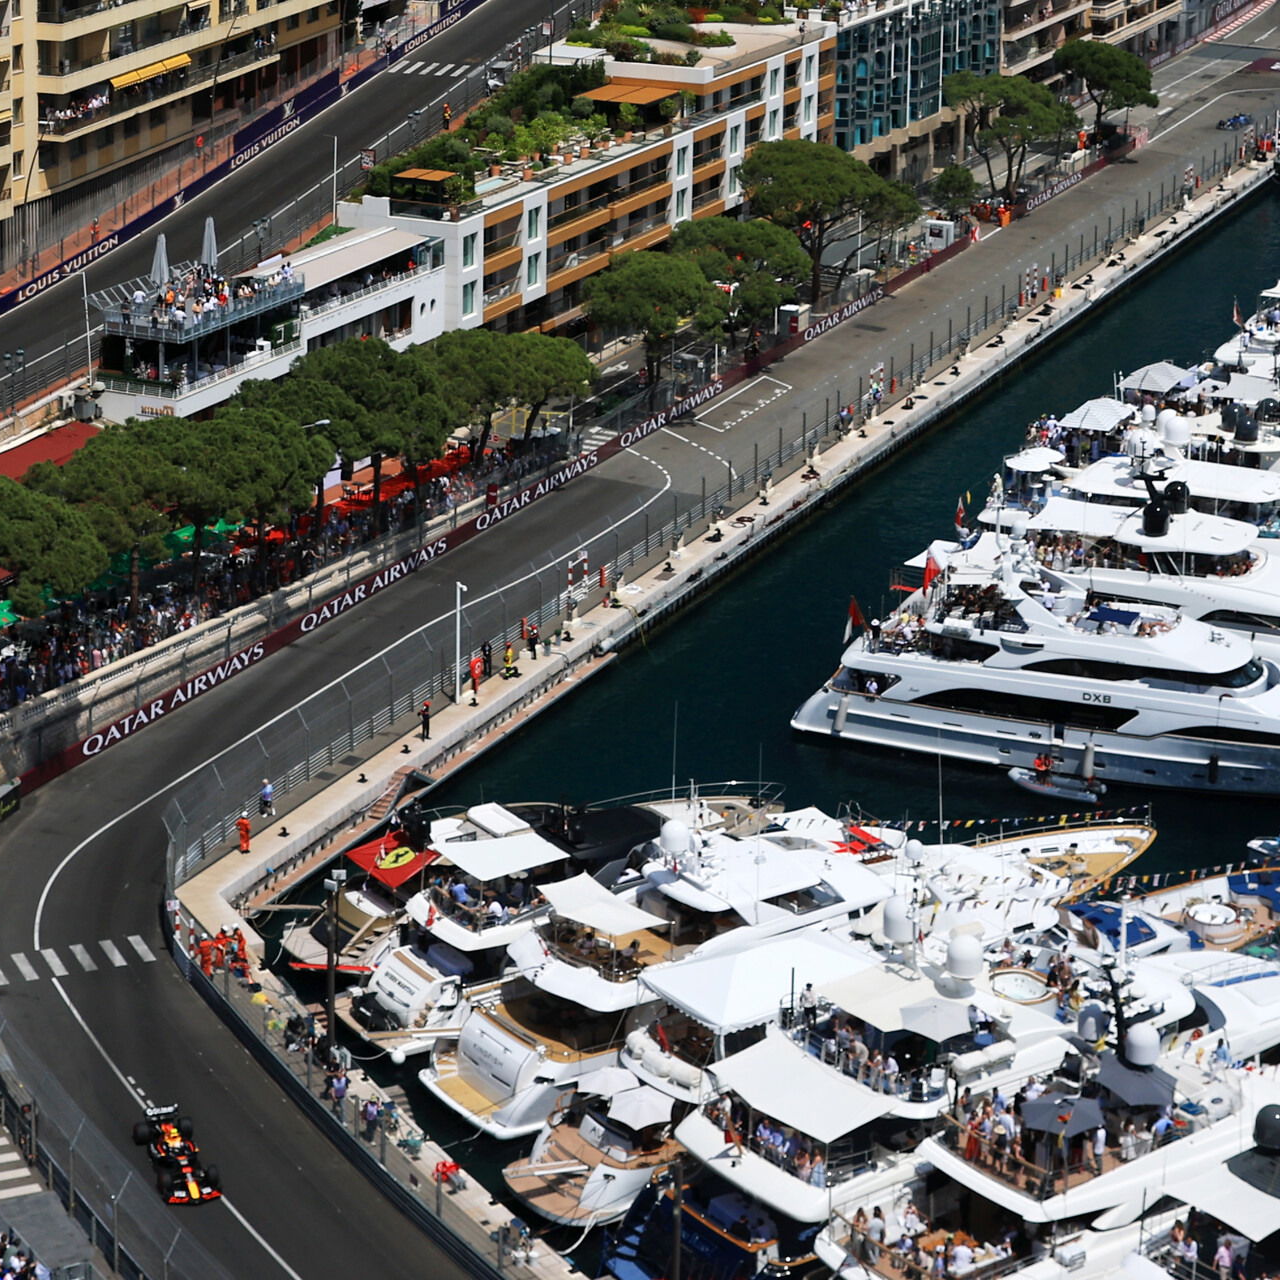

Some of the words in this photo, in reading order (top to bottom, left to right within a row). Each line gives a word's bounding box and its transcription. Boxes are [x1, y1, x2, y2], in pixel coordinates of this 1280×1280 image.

[404, 28, 429, 54] LOUIS
[428, 9, 461, 38] VUITTON
[230, 142, 260, 170] LOUIS
[261, 116, 301, 148] VUITTON
[1026, 189, 1052, 210] QATAR
[18, 269, 61, 302] LOUIS
[63, 234, 119, 273] VUITTON
[804, 312, 840, 341] QATAR
[841, 287, 884, 320] AIRWAYS
[620, 411, 667, 448] QATAR
[669, 379, 723, 421] AIRWAYS
[475, 489, 531, 531] QATAR
[534, 451, 598, 500] AIRWAYS
[300, 584, 367, 632] QATAR
[370, 537, 447, 593] AIRWAYS
[82, 699, 165, 756] QATAR
[170, 641, 265, 709] AIRWAYS
[1082, 692, 1112, 704] DXB
